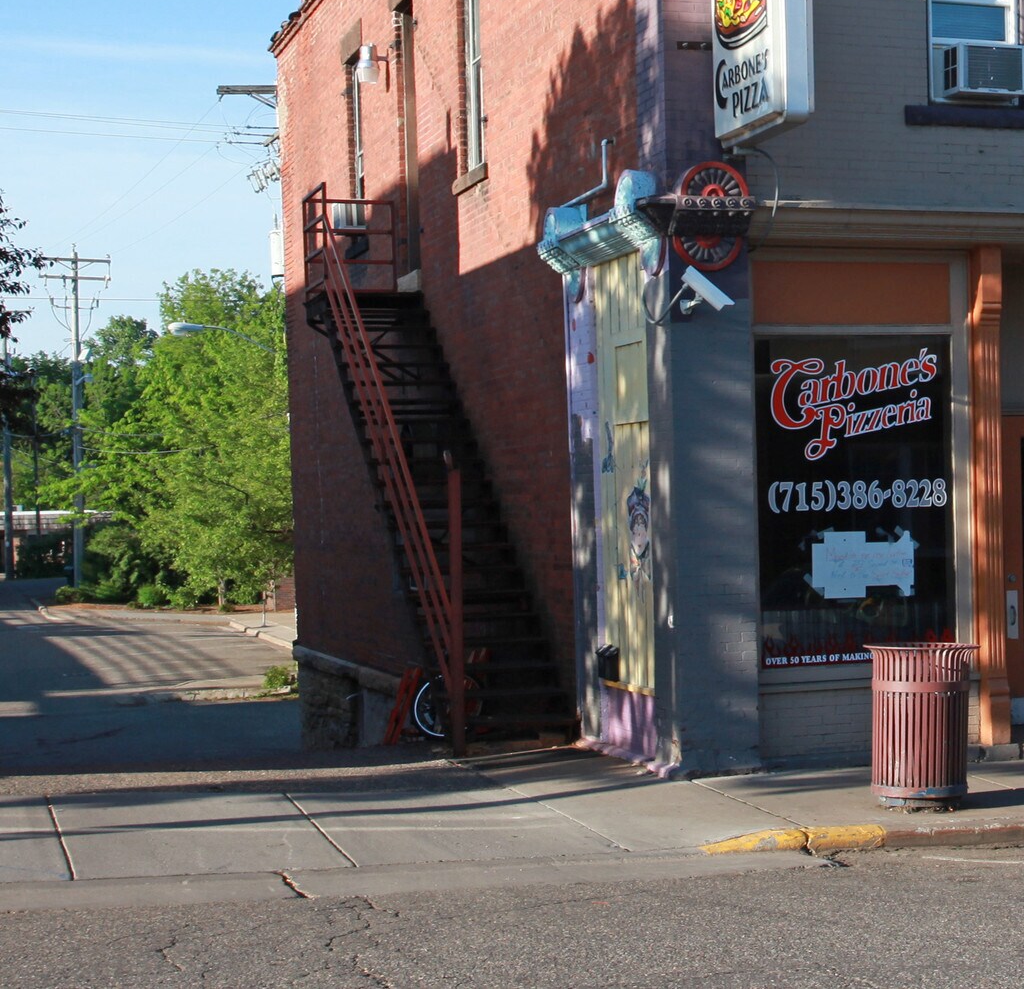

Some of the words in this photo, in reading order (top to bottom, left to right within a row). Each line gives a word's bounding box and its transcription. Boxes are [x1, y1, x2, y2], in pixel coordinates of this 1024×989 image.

[731, 76, 770, 119] PIZZA
[770, 348, 938, 430] Carbone's
[804, 390, 933, 461] Pizzeria
[768, 478, 948, 514] (715)386-8228
[765, 657, 788, 666] OVER
[790, 655, 799, 664] 50
[801, 654, 827, 664] YEARS
[829, 653, 840, 662] OF
